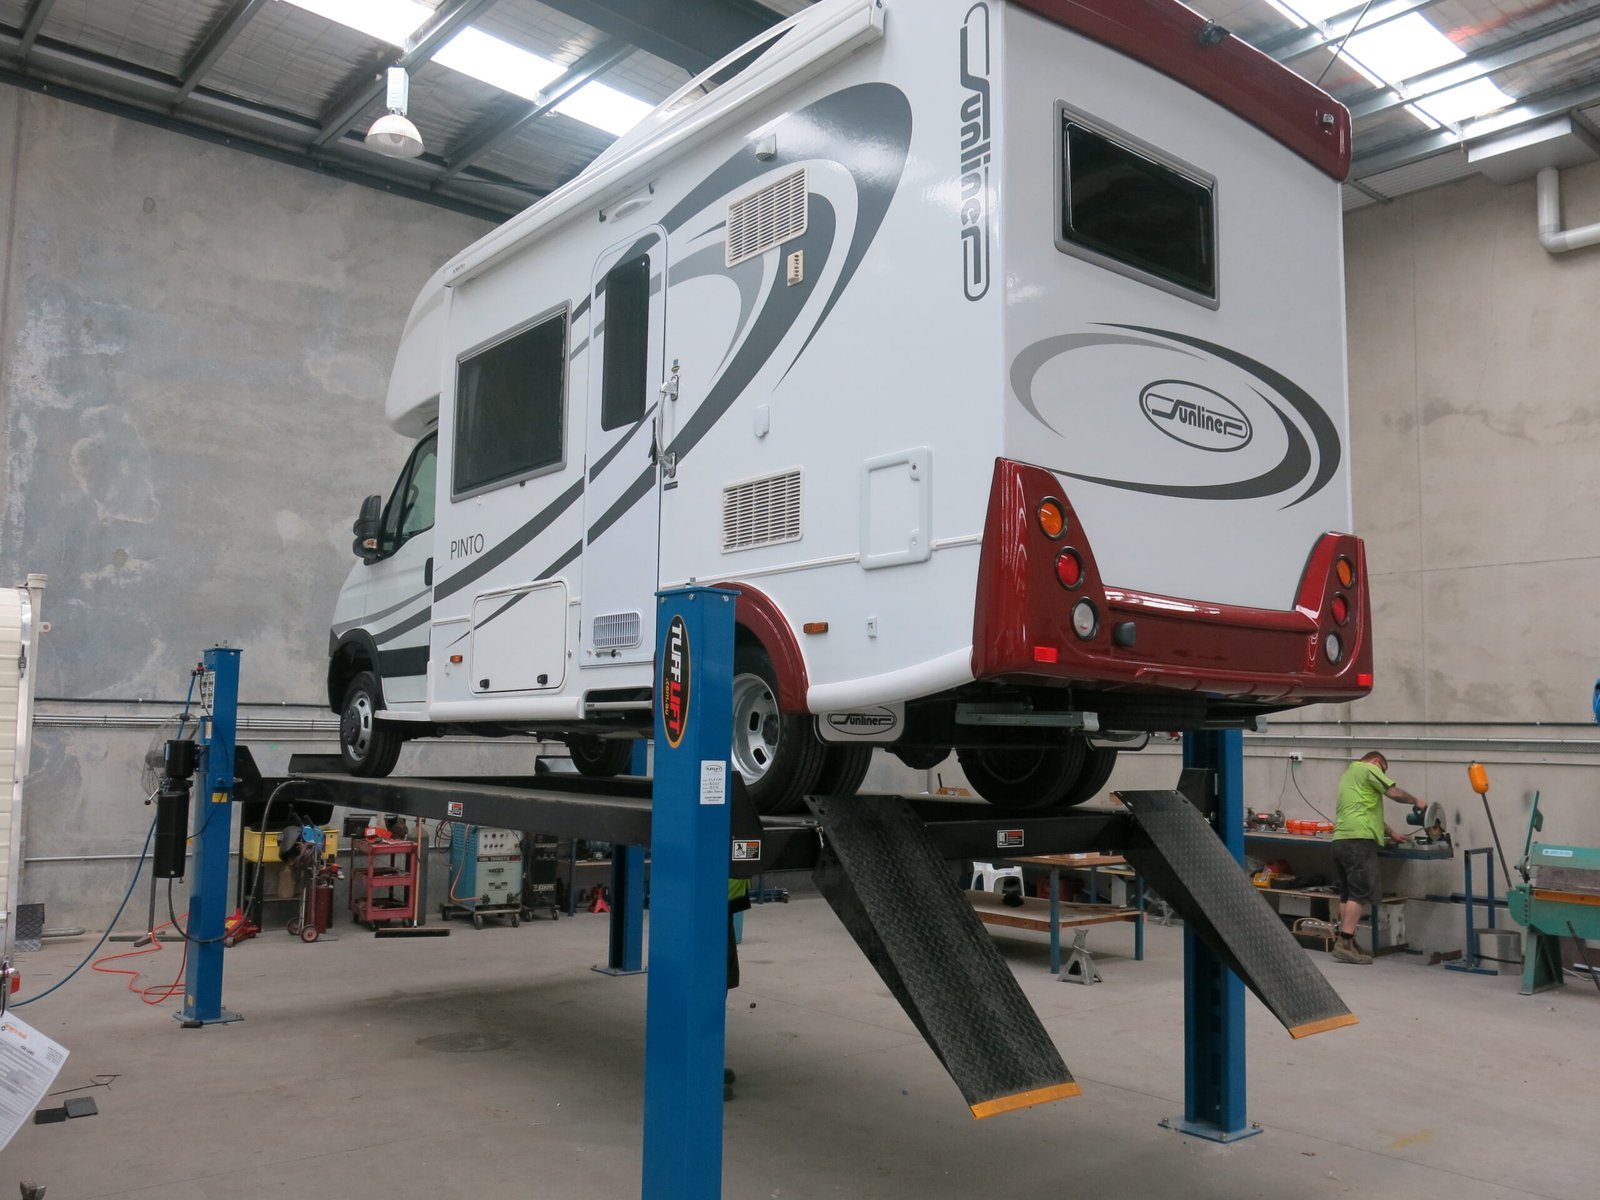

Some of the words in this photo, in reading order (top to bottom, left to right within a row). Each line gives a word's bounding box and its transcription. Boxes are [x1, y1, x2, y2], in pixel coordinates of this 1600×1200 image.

[960, 2, 990, 301] Sunliner
[1145, 393, 1248, 439] Sunliner
[451, 533, 484, 560] PINTO
[670, 624, 682, 735] TUFFLIFT
[830, 713, 895, 725] Sunliner
